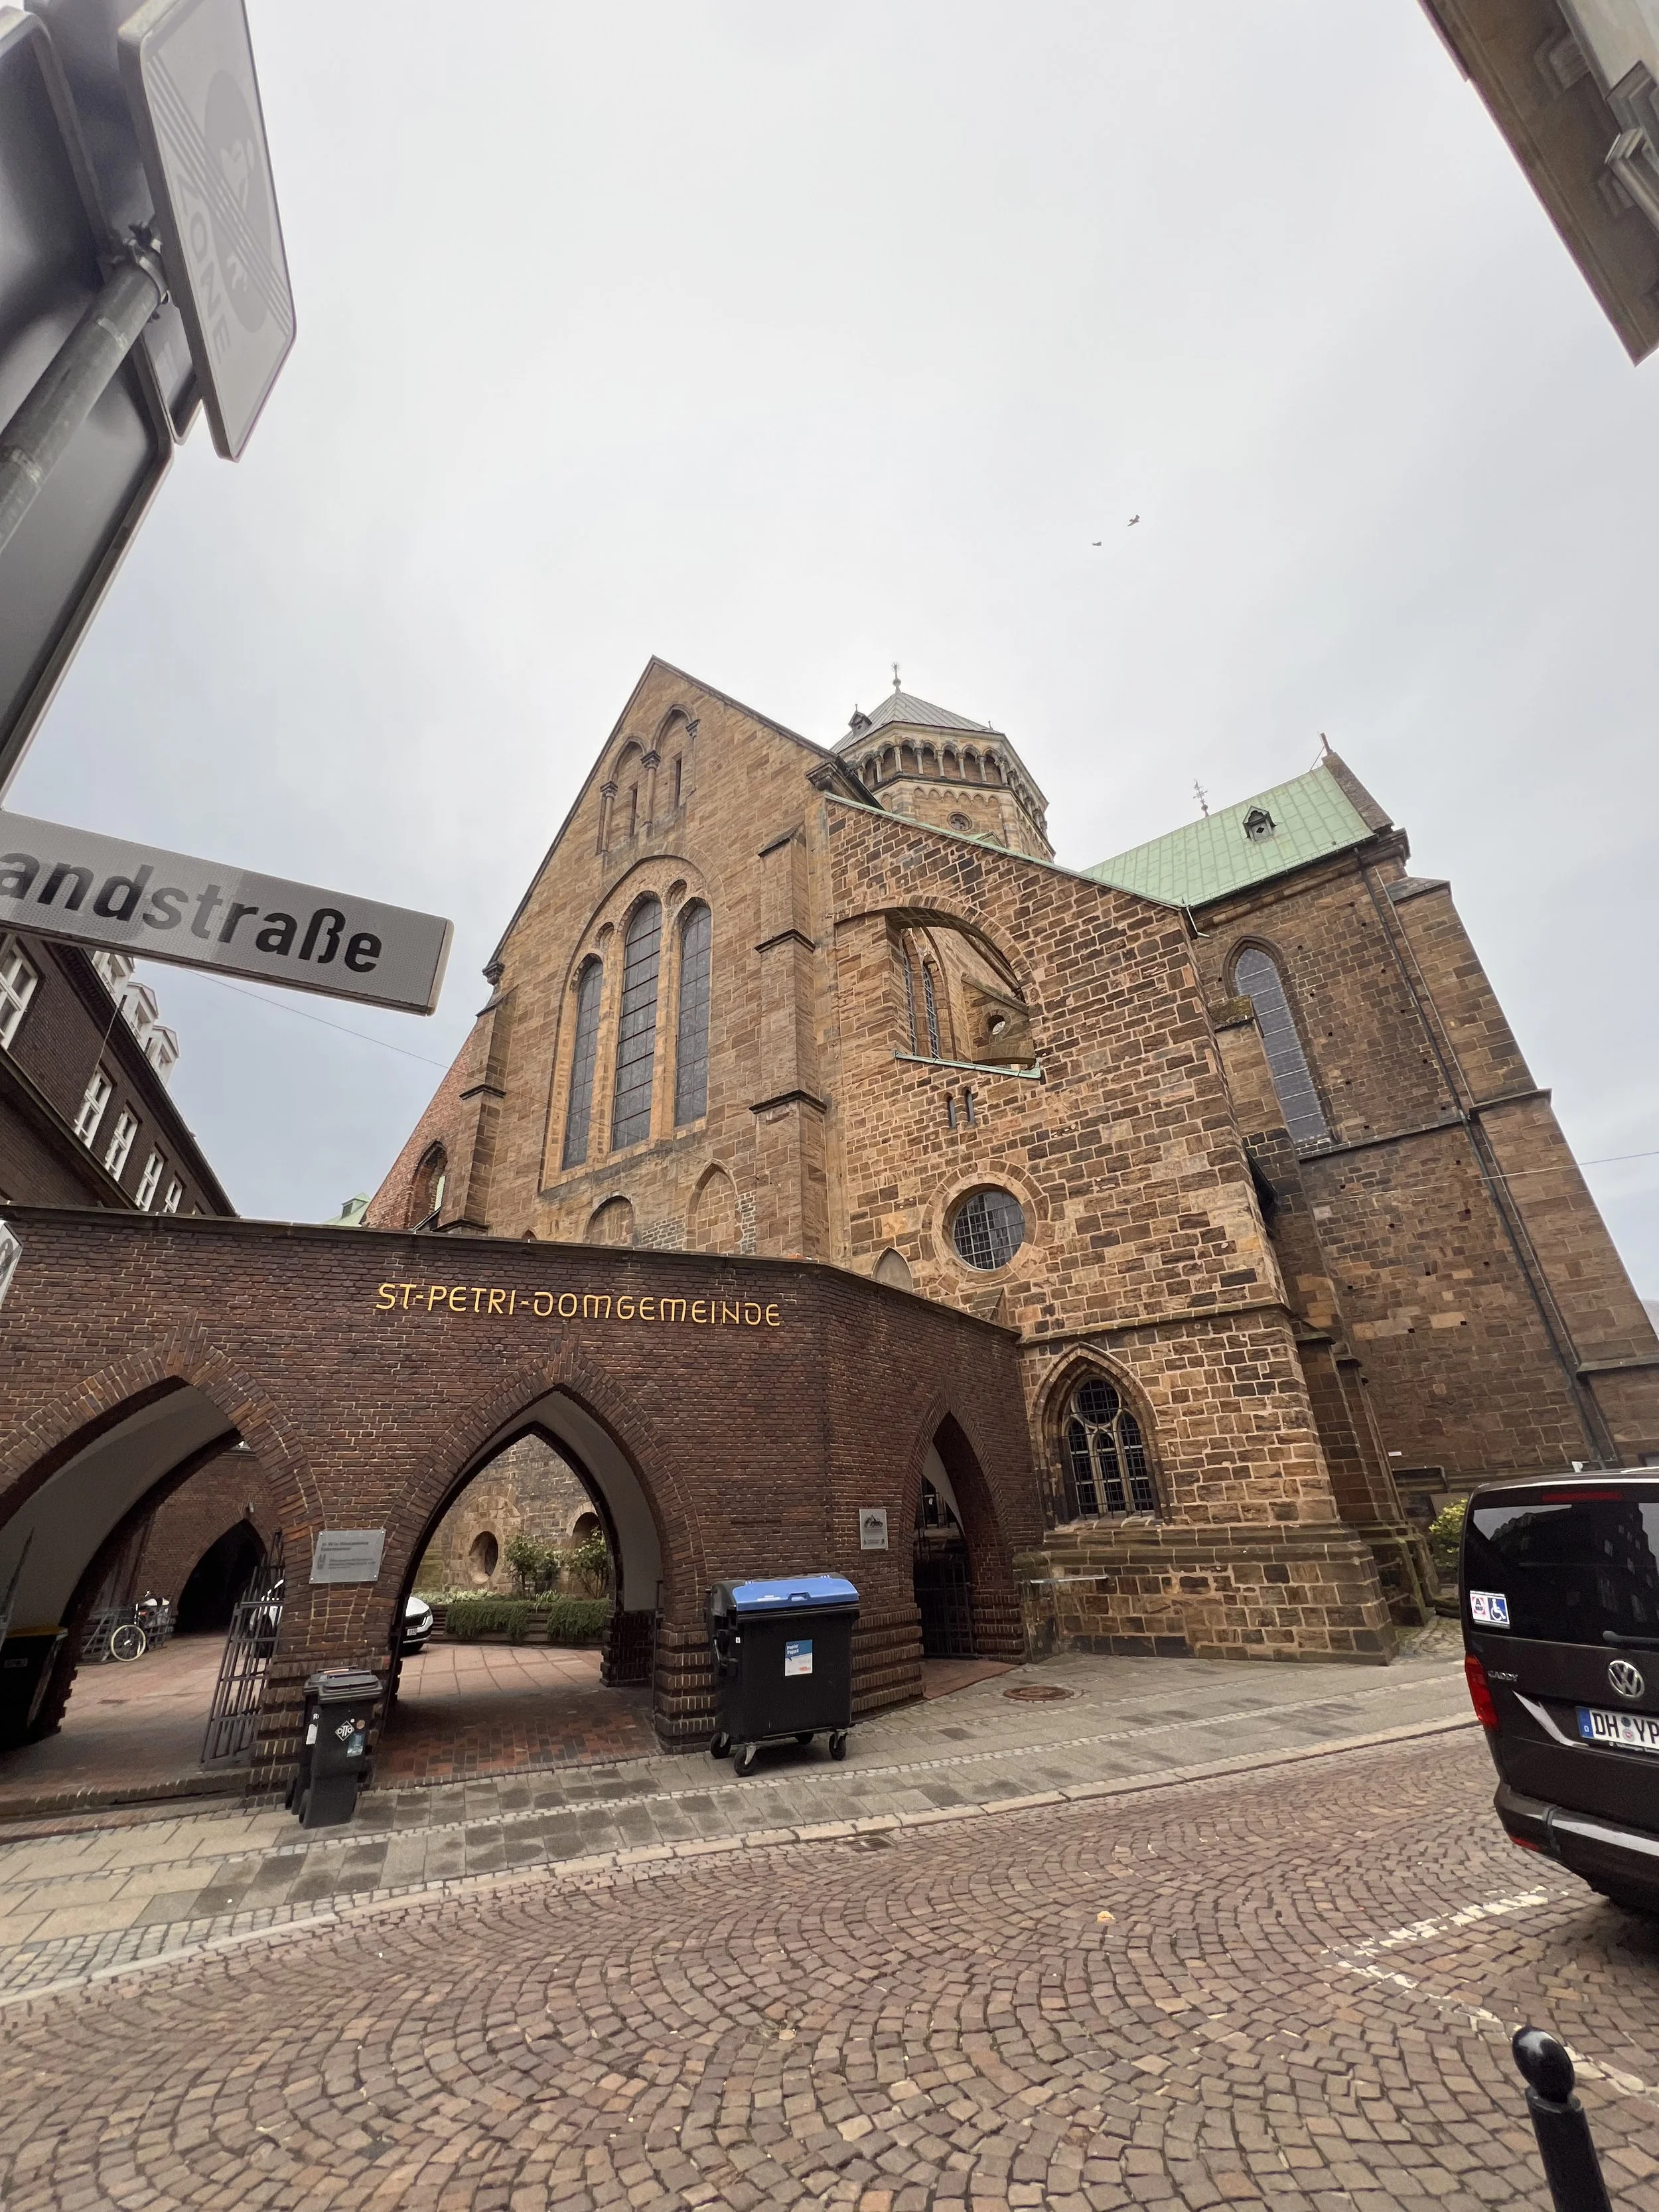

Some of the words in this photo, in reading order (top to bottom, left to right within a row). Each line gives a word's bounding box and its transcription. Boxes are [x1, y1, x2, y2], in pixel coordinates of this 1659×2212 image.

[175, 173, 232, 365] ZONE
[376, 1283, 782, 1327] ST-PETRI-DOMGEMEINDE
[1487, 1670, 1518, 1682] CADDY
[337, 1724, 353, 1737] OTTO
[1592, 1712, 1620, 1738] DH
